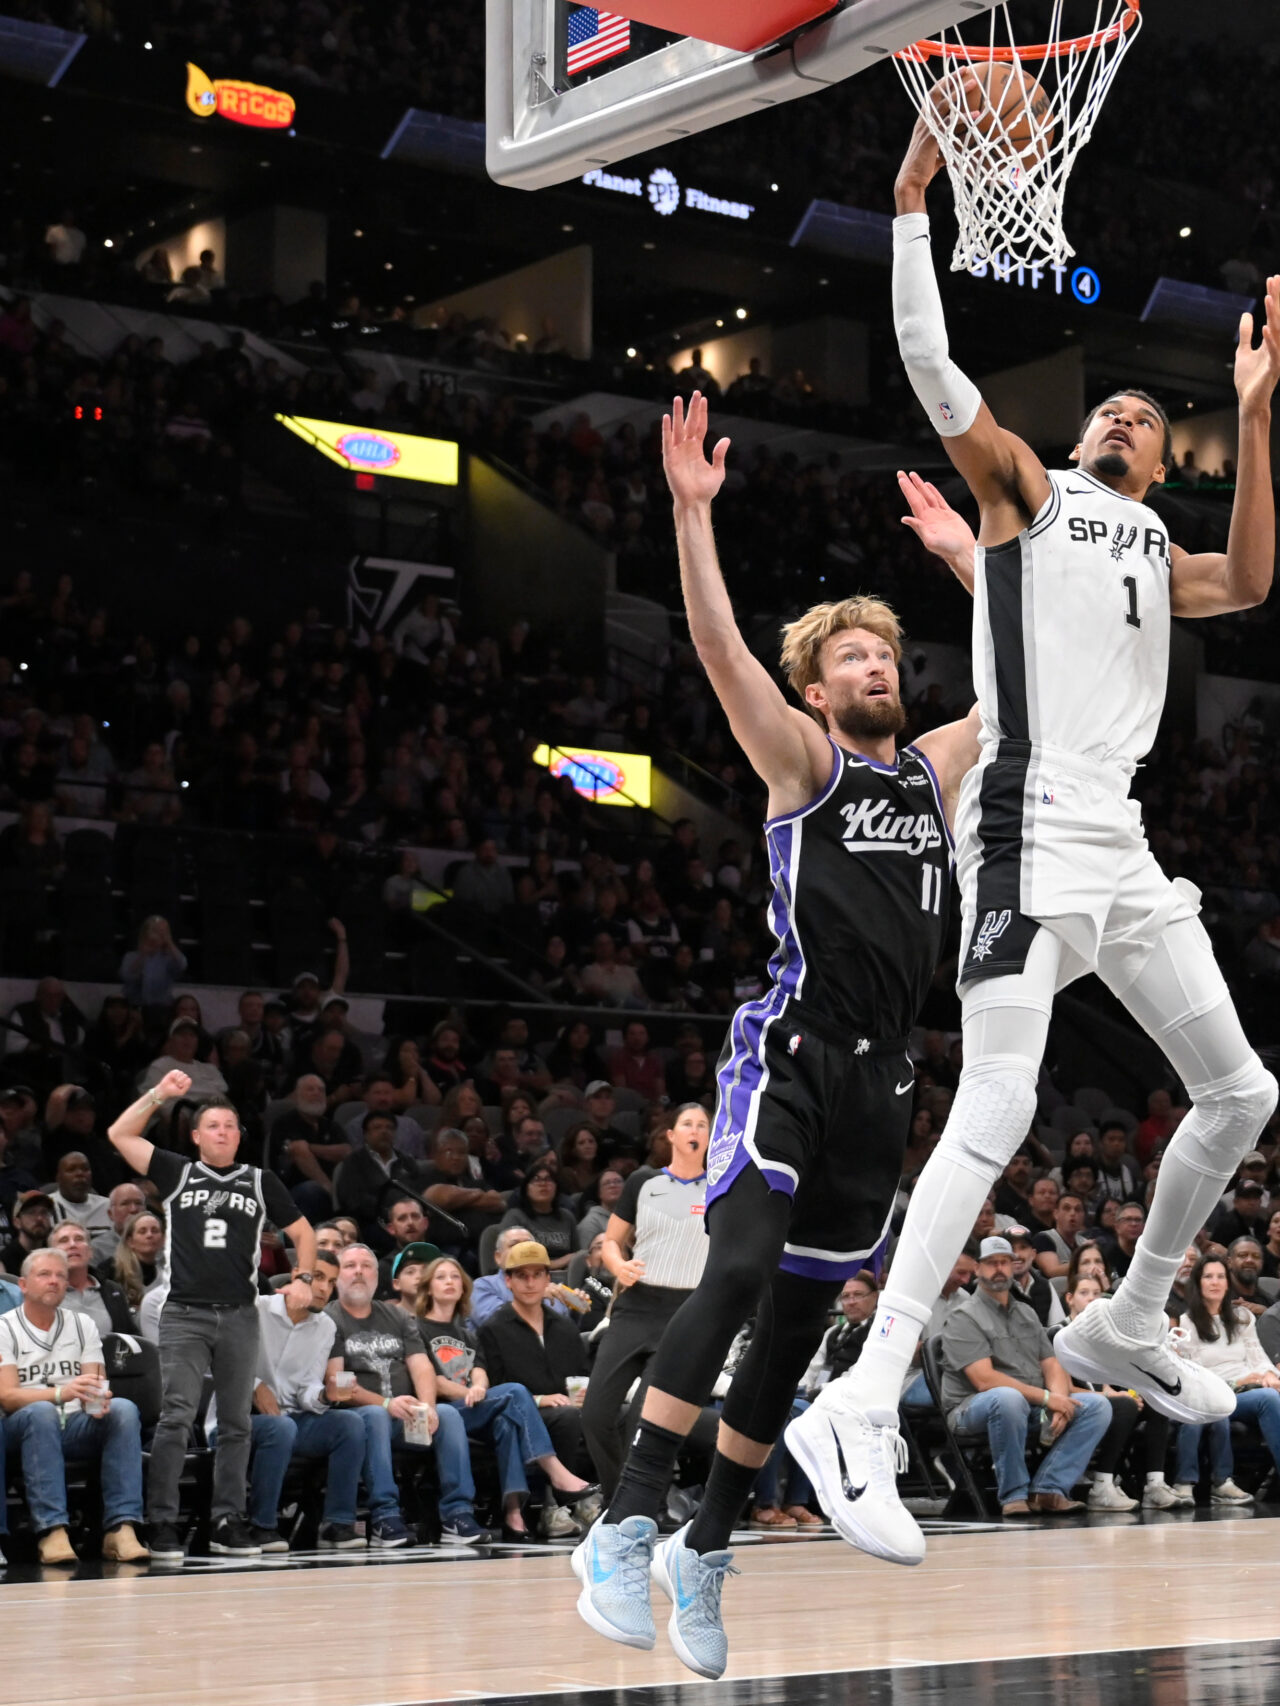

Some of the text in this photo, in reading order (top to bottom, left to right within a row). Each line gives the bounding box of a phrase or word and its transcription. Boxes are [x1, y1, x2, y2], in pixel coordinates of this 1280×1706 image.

[685, 187, 751, 220] Fitness
[1121, 574, 1142, 631] 1
[839, 798, 942, 856] Kings
[921, 862, 942, 915] 11
[204, 1218, 228, 1248] 2
